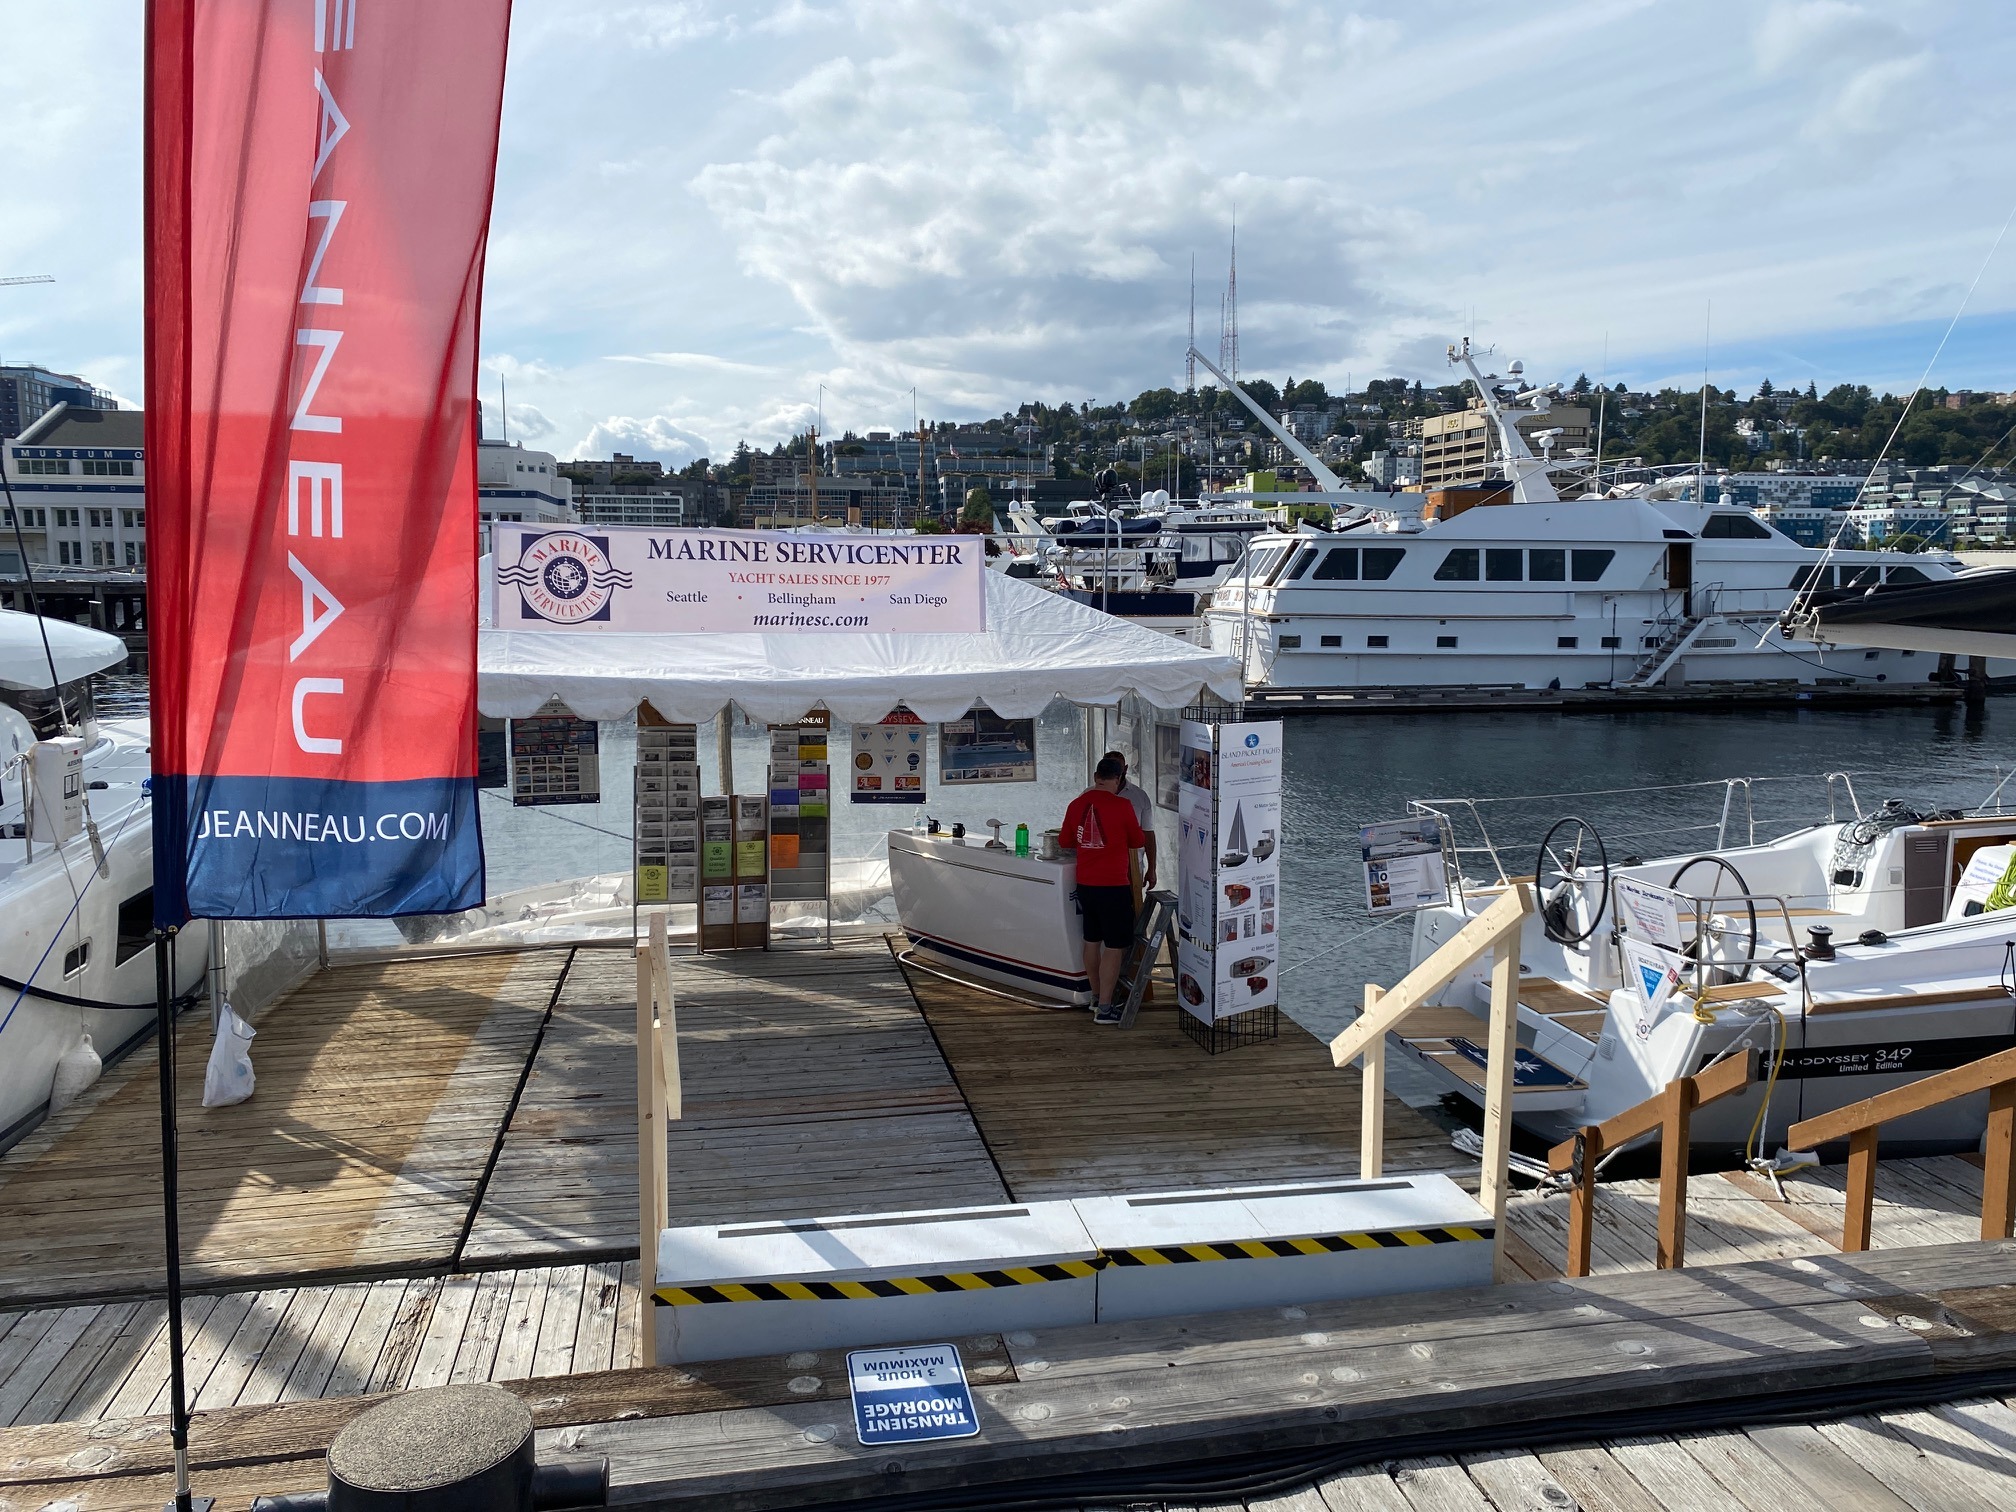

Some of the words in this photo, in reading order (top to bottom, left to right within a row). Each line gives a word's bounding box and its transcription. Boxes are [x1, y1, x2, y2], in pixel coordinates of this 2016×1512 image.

[20, 449, 114, 458] MUSEUM
[532, 539, 600, 566] MARINE
[647, 538, 769, 562] MARINE
[776, 541, 963, 565] SERVICENTER
[728, 572, 775, 584] YACHT
[778, 573, 818, 584] SALES
[822, 574, 861, 585] SINCE
[864, 575, 890, 586] 1977
[530, 587, 602, 617] SERVICENTER
[666, 590, 708, 603] Seattle
[768, 592, 836, 608] Bellingham
[890, 593, 911, 605] San
[914, 593, 948, 608] Diego
[753, 612, 870, 626] marinesc.com
[1221, 750, 1241, 759] ISLAND
[1242, 749, 1261, 757] PACKET
[1262, 747, 1280, 755] YACHTS
[197, 809, 449, 843] JEANNEAU.COM
[1800, 1054, 1869, 1066] ODYSSEY
[1875, 1048, 1912, 1062] 349
[1840, 1063, 1869, 1072] Limited
[1876, 1062, 1902, 1070] Edition
[863, 1356, 944, 1371] MAXIMUM
[878, 1370, 922, 1381] HOUR
[928, 1368, 936, 1377] 3
[864, 1397, 963, 1418] MOORAGE
[866, 1412, 969, 1432] TRANSIENT
